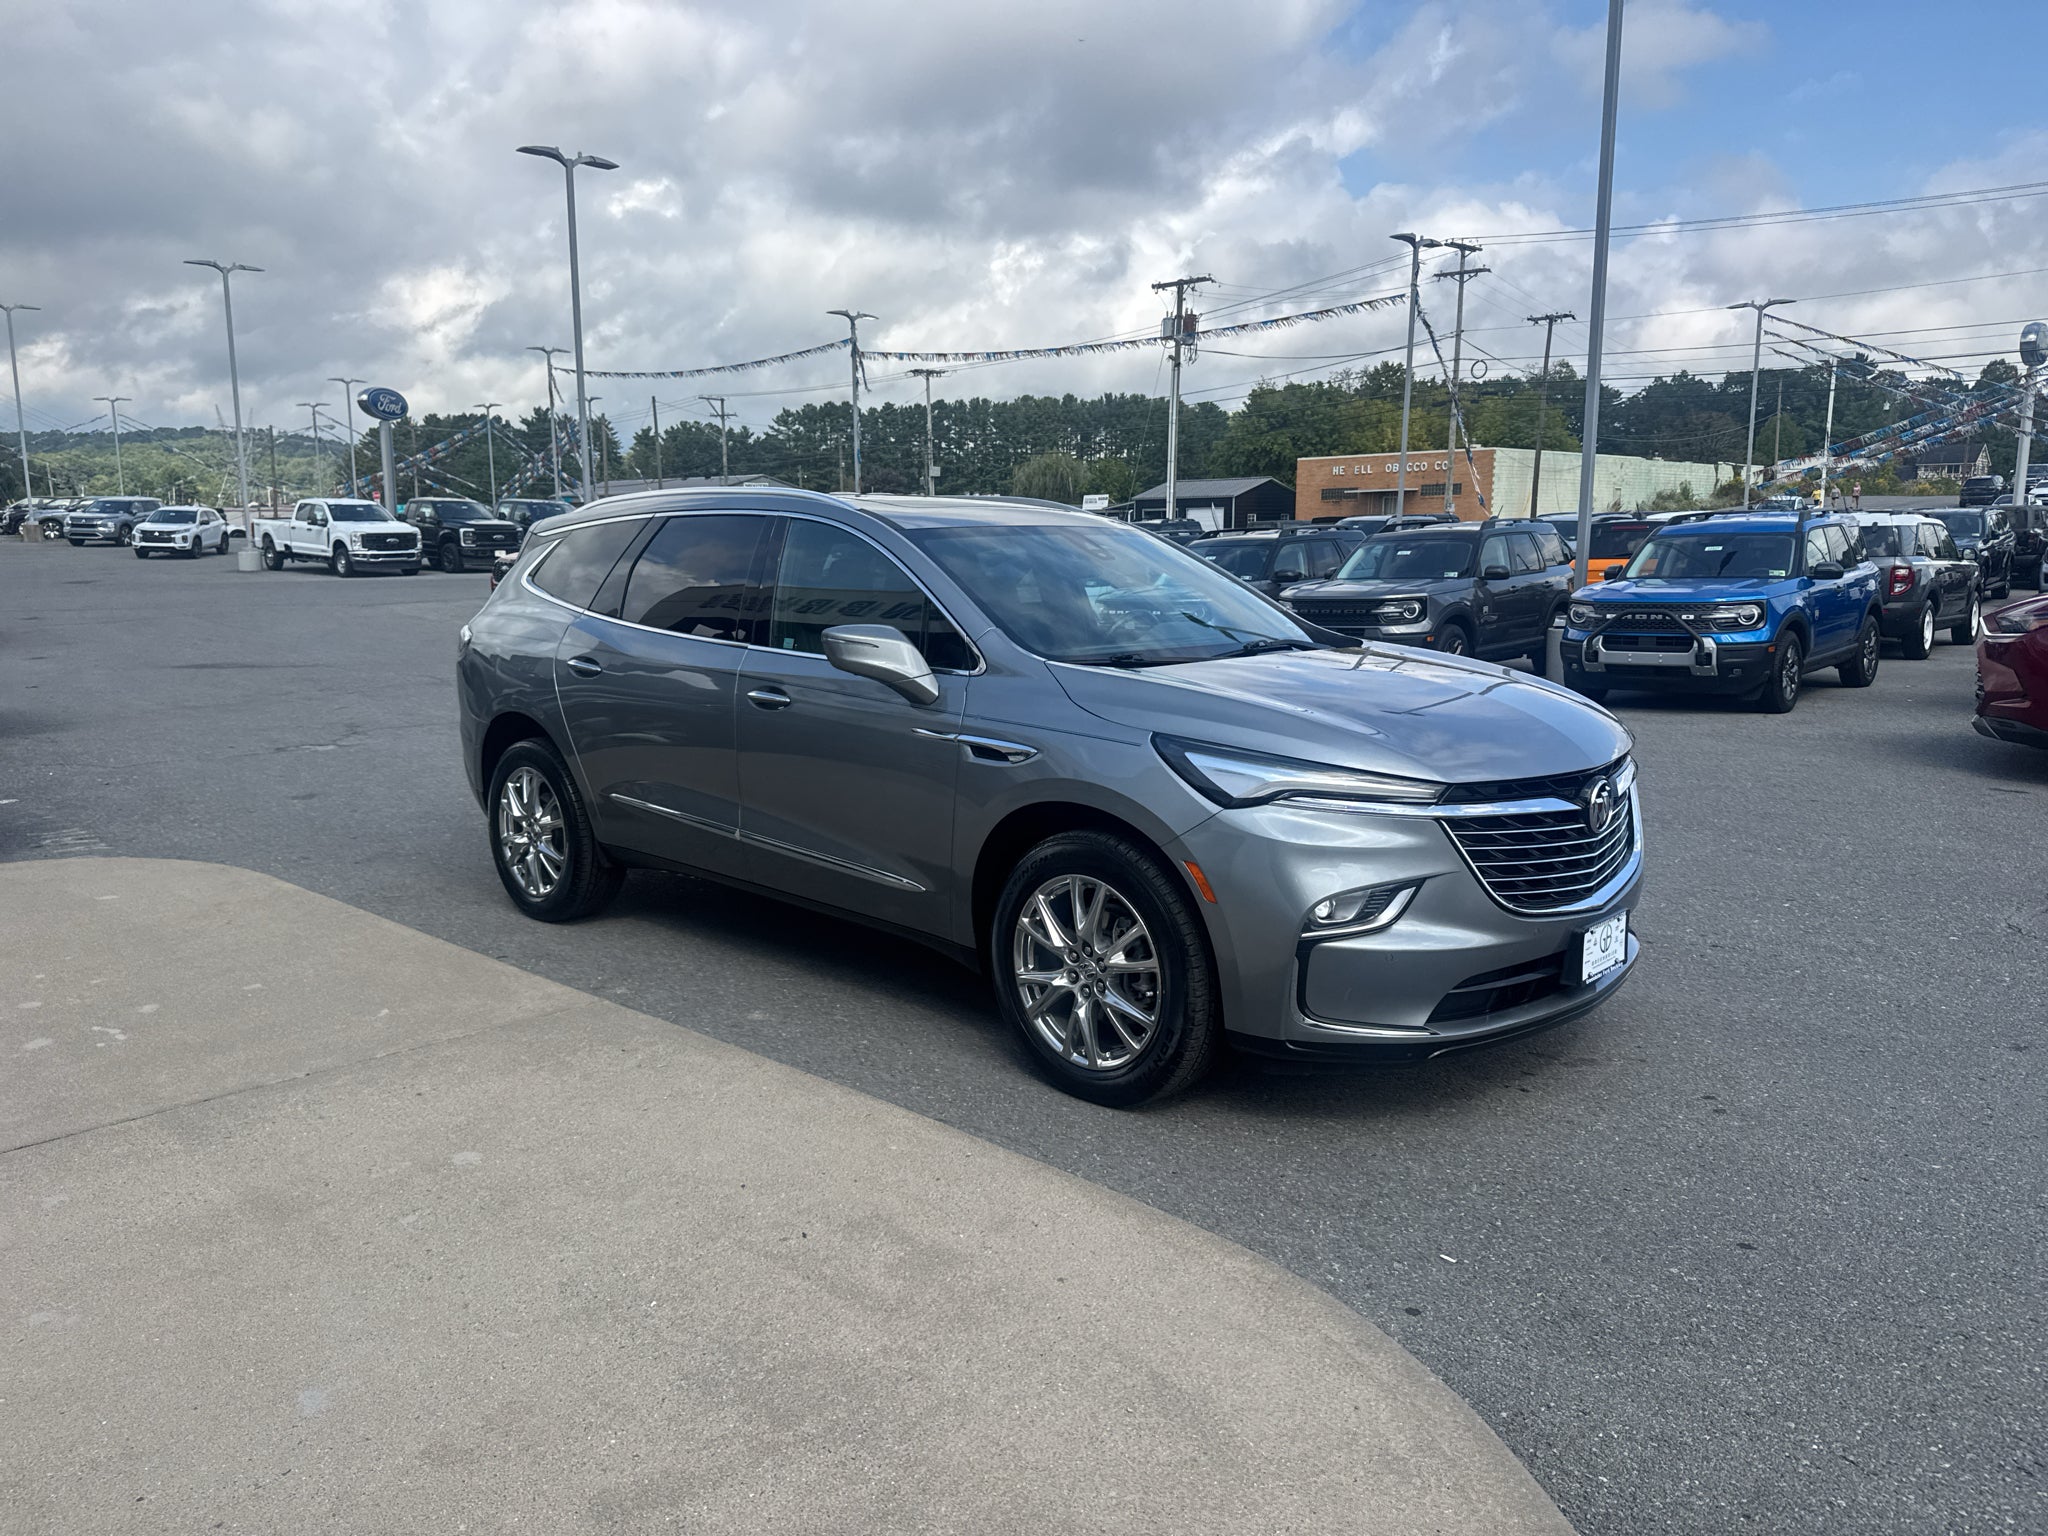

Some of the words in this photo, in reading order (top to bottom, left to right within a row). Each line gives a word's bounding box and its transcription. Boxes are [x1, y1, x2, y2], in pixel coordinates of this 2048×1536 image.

[377, 393, 402, 414] Ford
[1354, 464, 1373, 474] ELL
[1385, 461, 1428, 473] OBCCO
